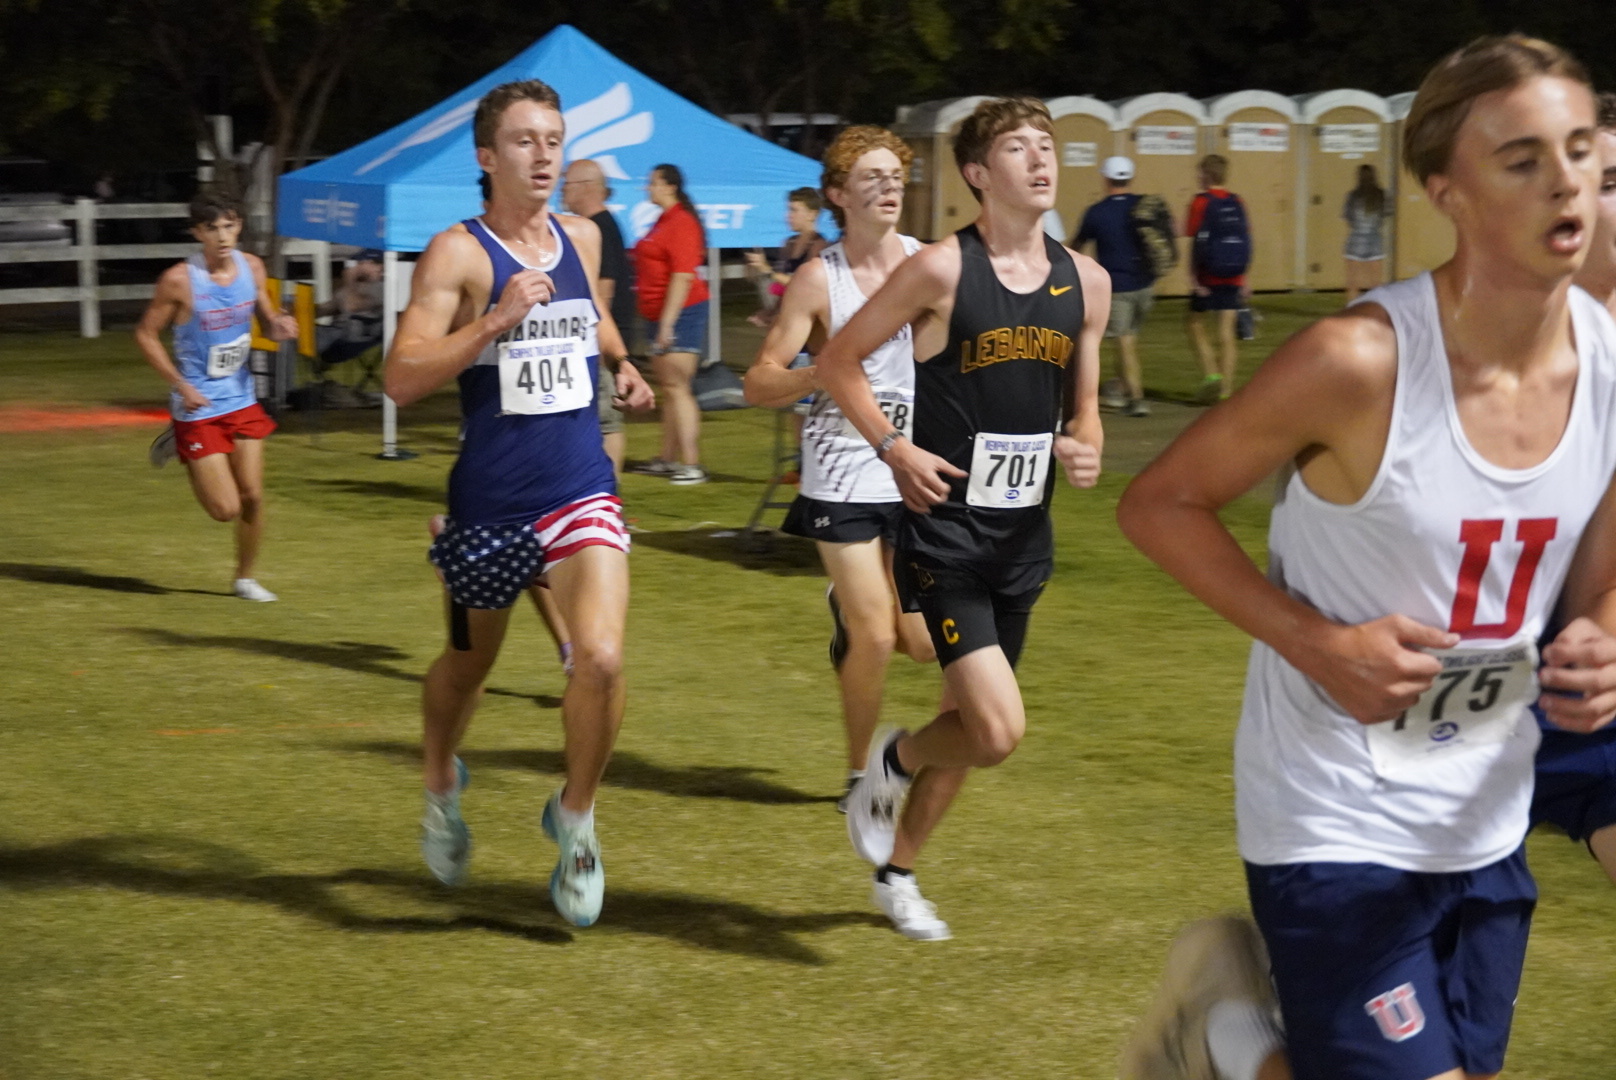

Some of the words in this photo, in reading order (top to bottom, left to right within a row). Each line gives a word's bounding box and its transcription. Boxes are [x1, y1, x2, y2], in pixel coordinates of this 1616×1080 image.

[517, 357, 574, 394] 404
[985, 454, 1037, 488] 701
[1448, 516, 1559, 640] U
[941, 618, 960, 645] C
[1364, 981, 1426, 1043] U
